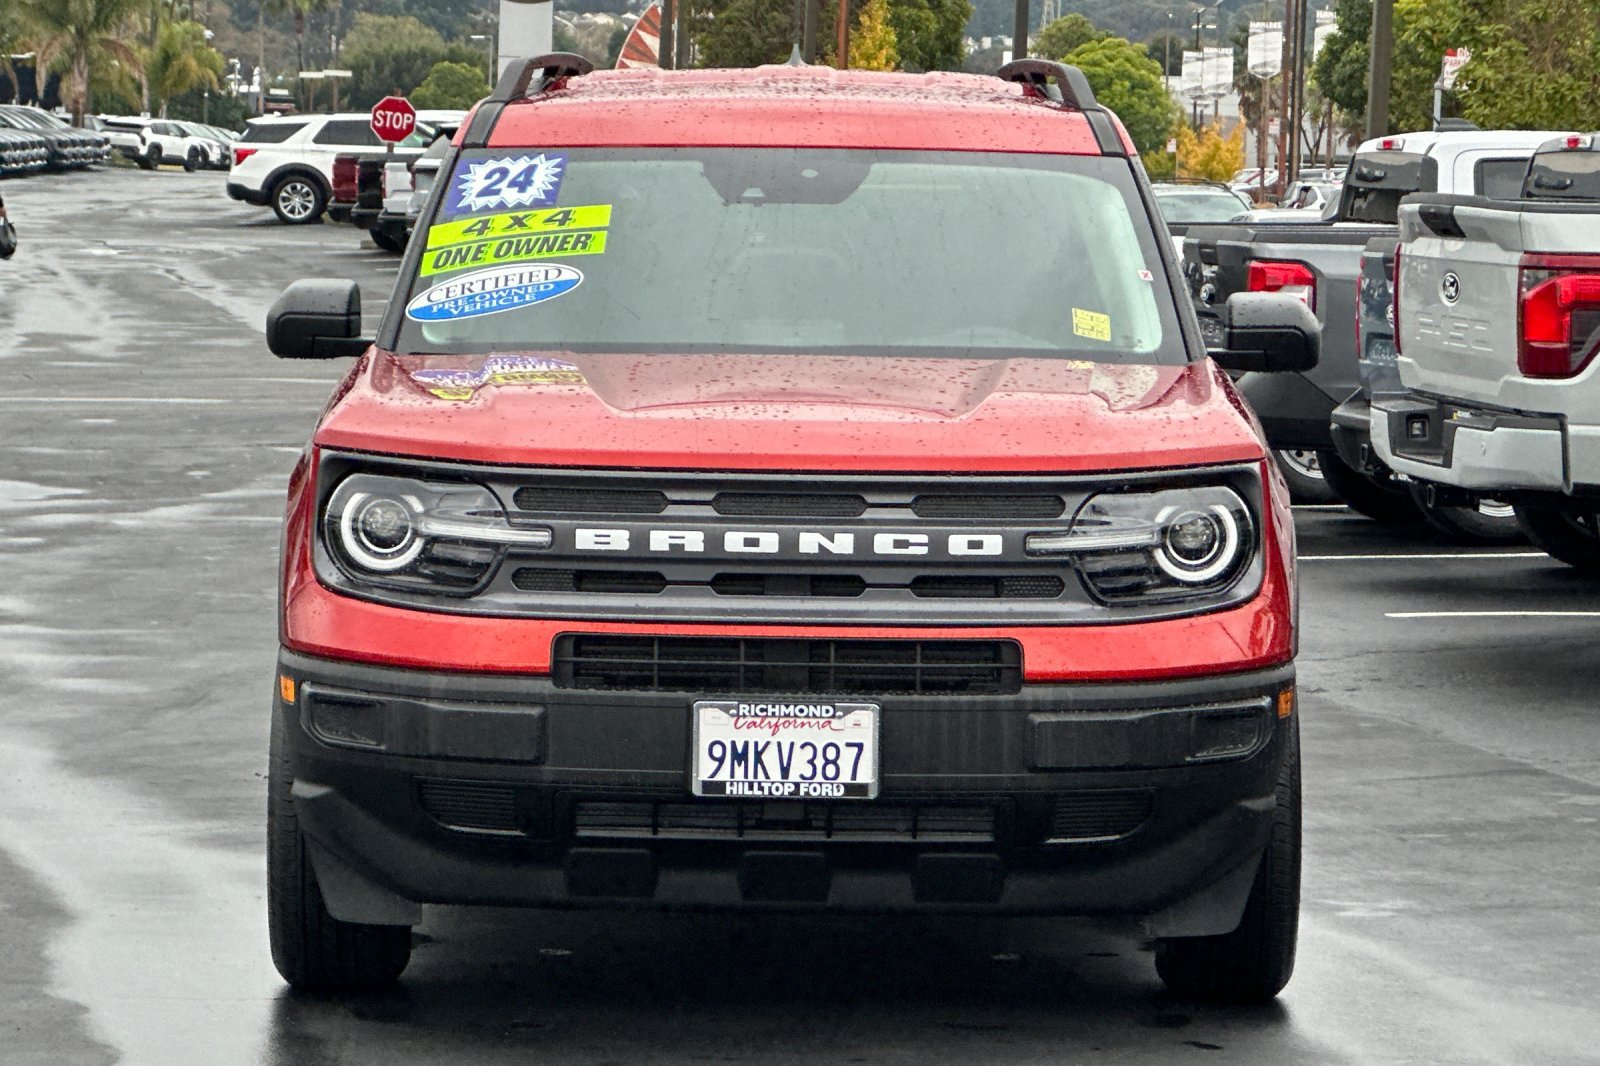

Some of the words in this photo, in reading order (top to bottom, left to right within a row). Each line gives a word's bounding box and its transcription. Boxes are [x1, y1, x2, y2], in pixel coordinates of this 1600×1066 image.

[374, 110, 413, 130] STOP
[475, 163, 538, 198] 24
[432, 242, 490, 270] ONE
[493, 233, 595, 262] OWNER
[426, 267, 563, 303] CERTIFIED
[430, 283, 555, 313] PRE-OWNED
[449, 292, 536, 316] VEHICLE
[575, 528, 1003, 555] BRONCO
[738, 704, 834, 718] RICHMOND
[733, 716, 845, 736] California
[707, 739, 865, 781] 9MKV387
[725, 781, 795, 796] HILLTOP
[799, 782, 845, 797] FORD
